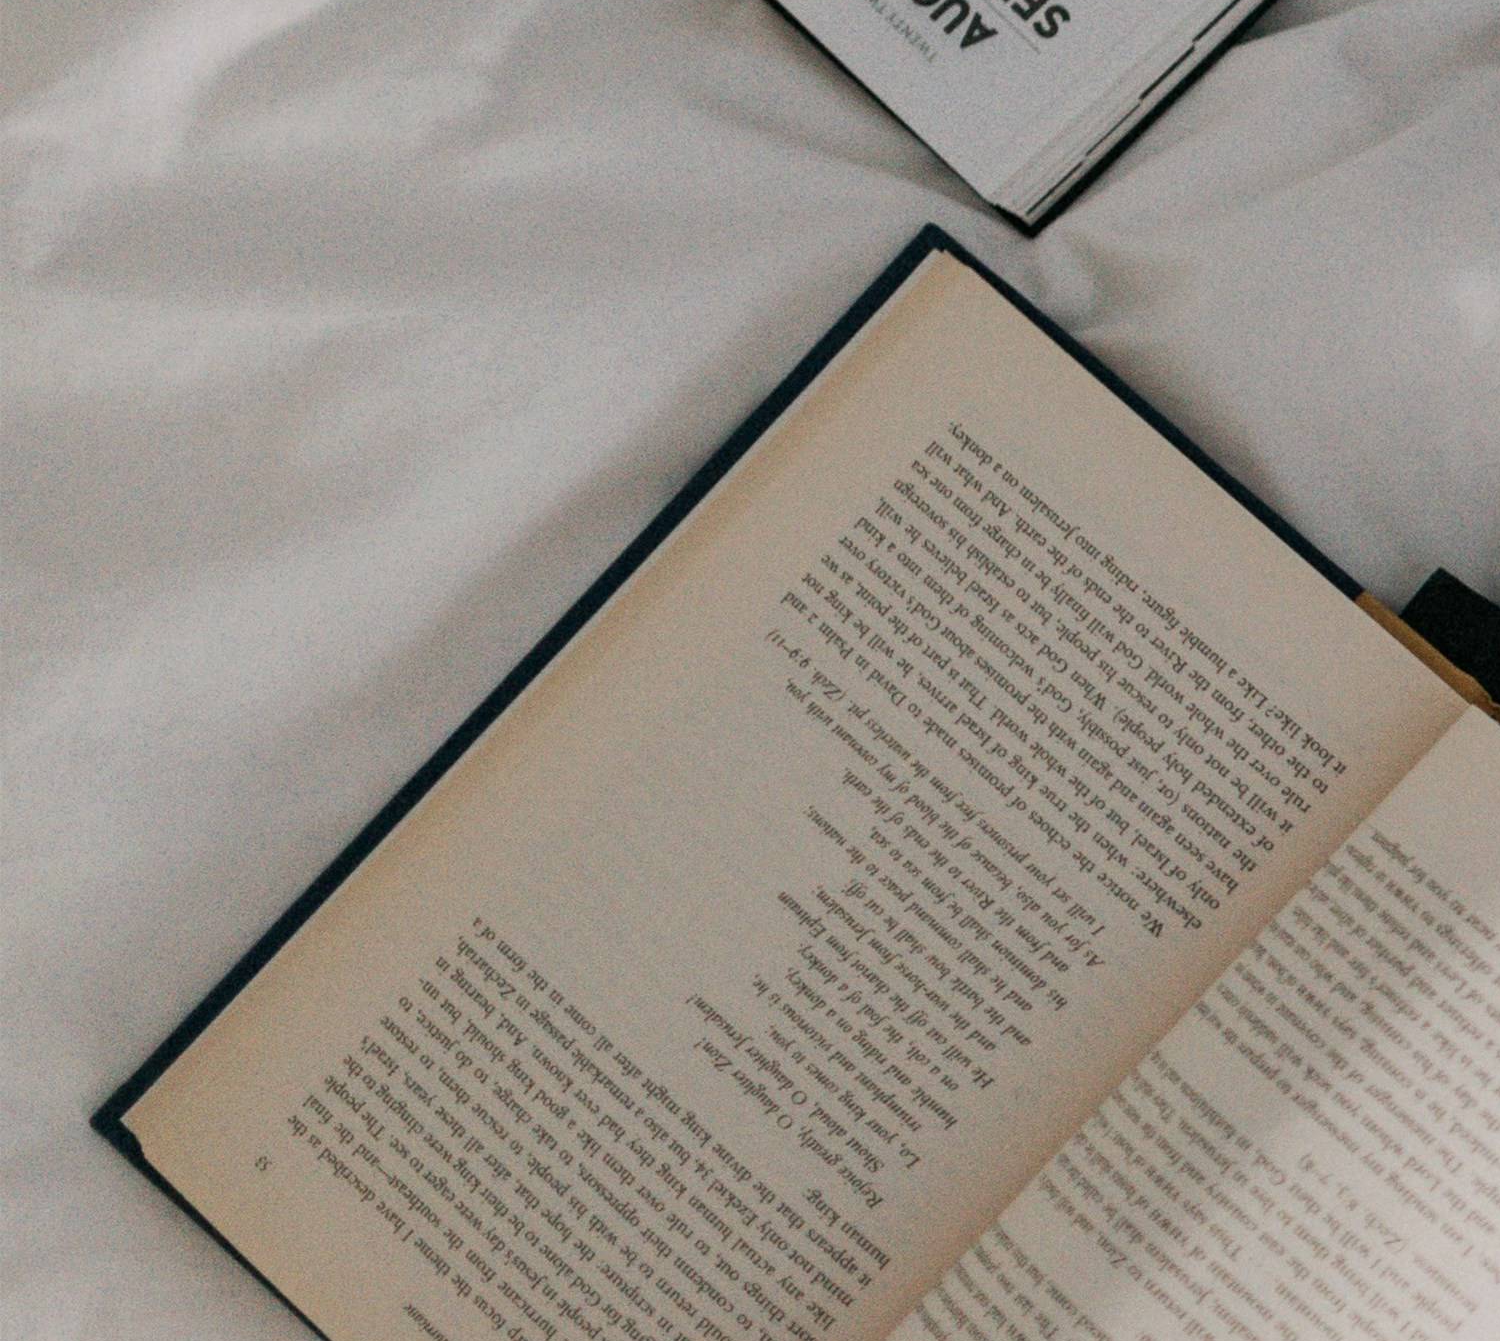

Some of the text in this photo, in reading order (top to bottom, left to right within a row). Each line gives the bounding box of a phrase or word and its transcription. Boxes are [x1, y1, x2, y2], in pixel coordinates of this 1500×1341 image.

[882, 7, 943, 65] TWENTY
[939, 415, 1080, 543] Jerusalem donkey.
[689, 1032, 888, 1213] Rejoice greatly, O daughter Zion!
[465, 1291, 509, 1334] focus
